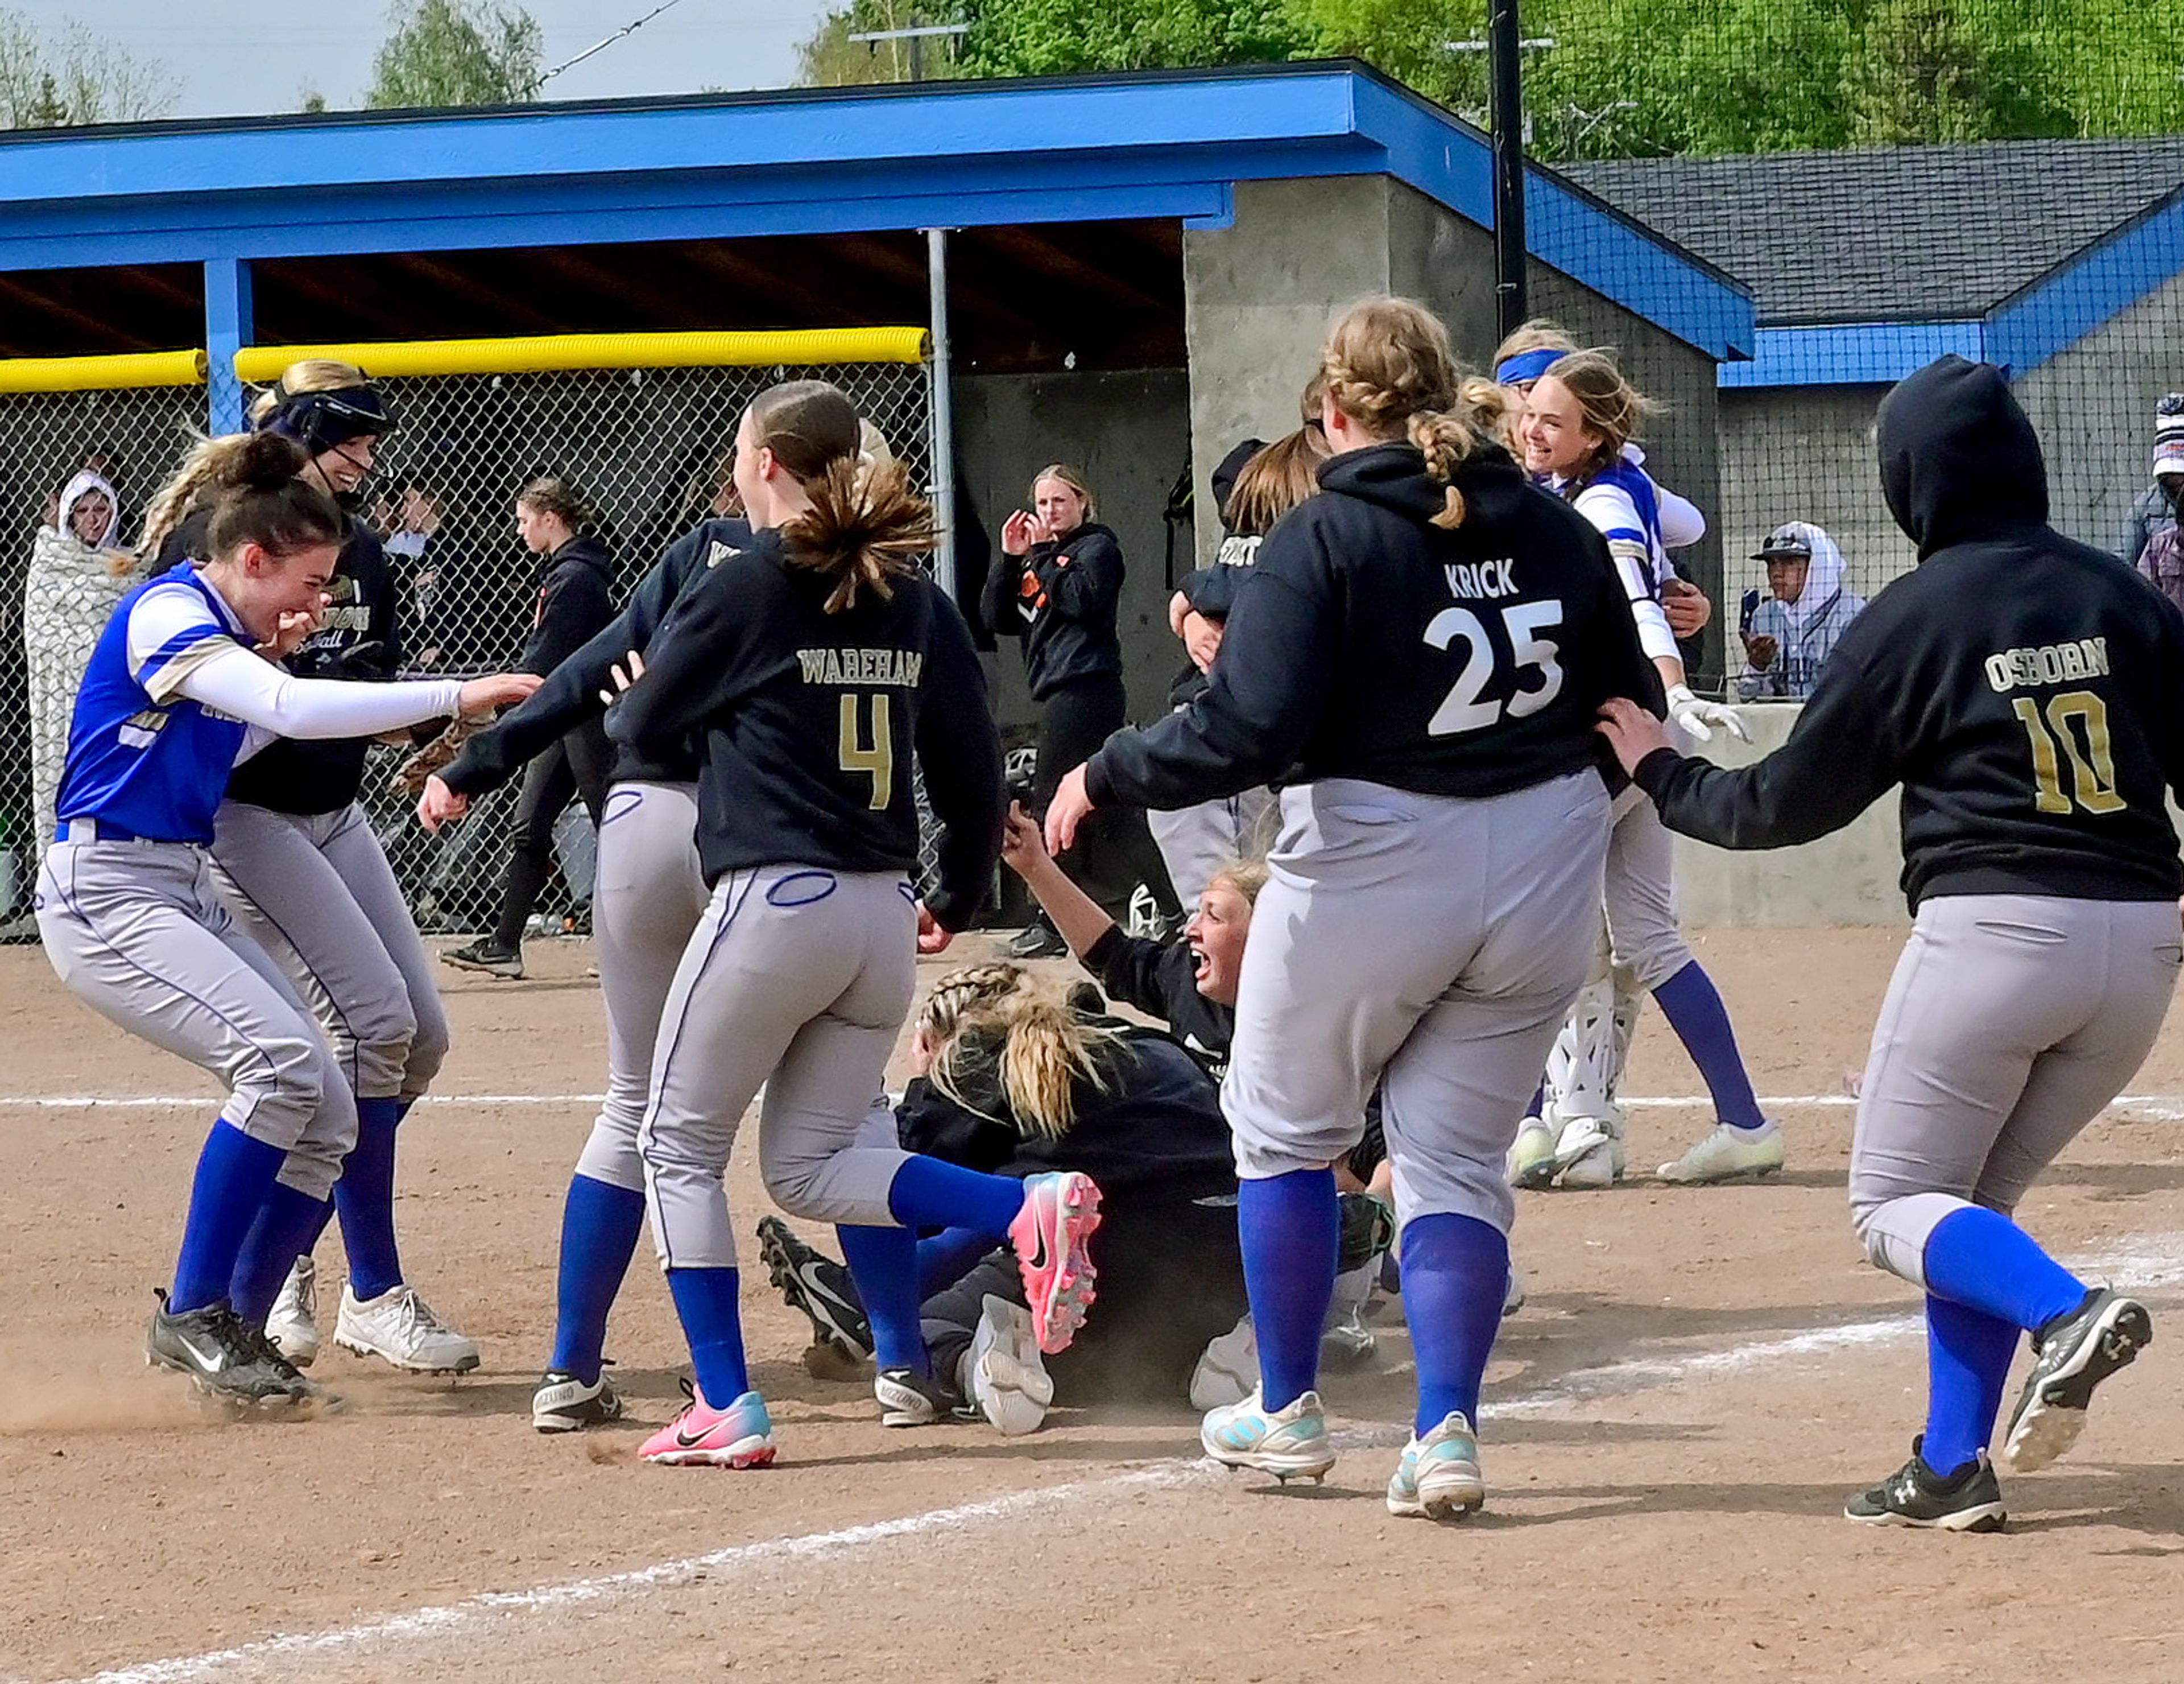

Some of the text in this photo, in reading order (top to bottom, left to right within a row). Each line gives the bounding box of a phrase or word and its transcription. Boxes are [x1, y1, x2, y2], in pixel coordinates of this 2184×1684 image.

[1443, 558, 1520, 599] KRICK
[796, 649, 923, 687] WAREHAM
[1422, 599, 1563, 736] 25
[1984, 637, 2110, 693] OSBORN
[838, 693, 892, 810] 4
[2011, 691, 2128, 815] 10
